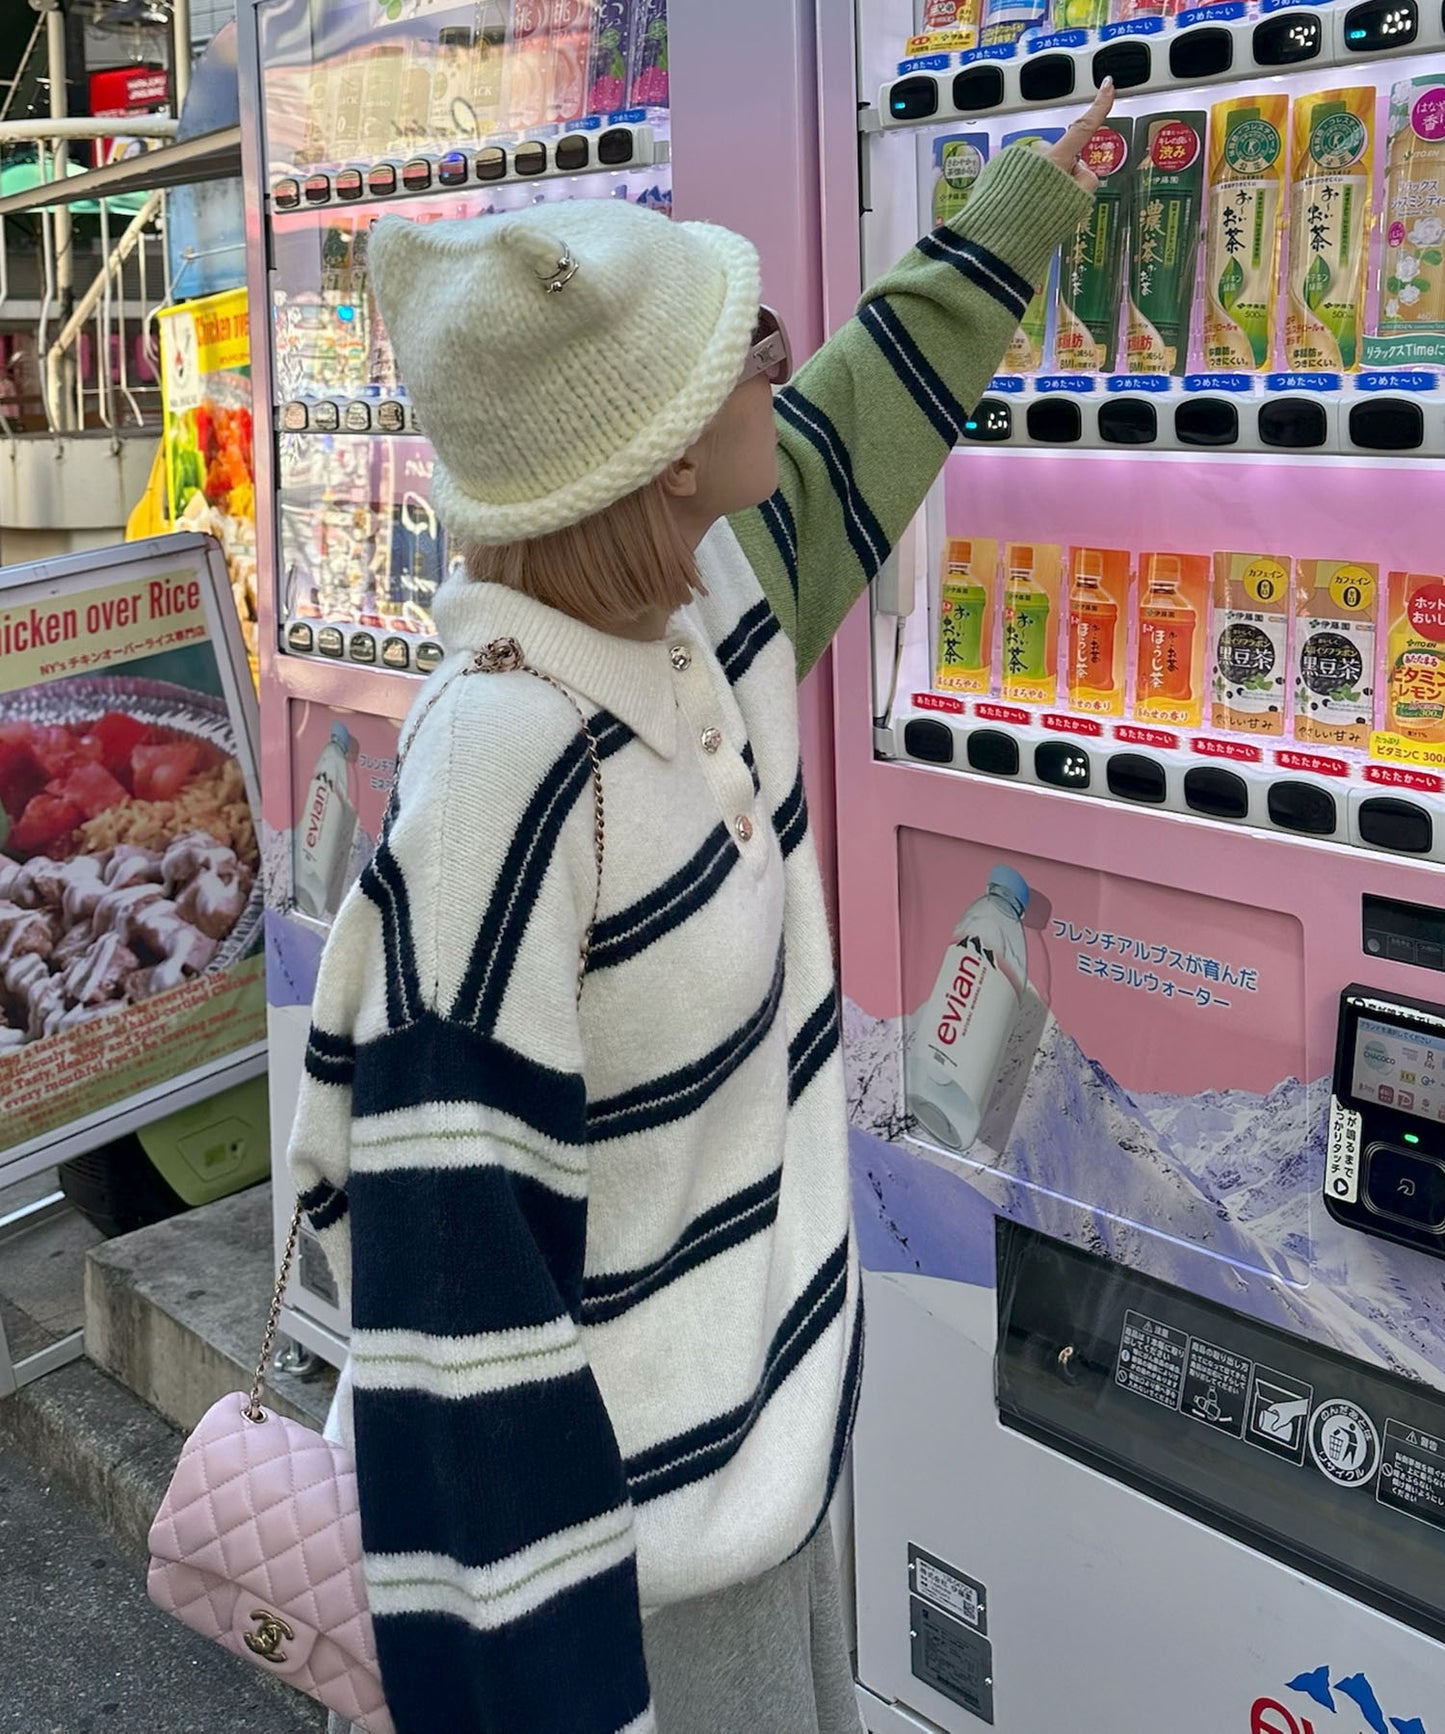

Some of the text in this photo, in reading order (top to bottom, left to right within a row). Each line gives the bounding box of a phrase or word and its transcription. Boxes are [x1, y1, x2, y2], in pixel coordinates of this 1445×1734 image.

[1108, 20, 1153, 37] つめた〜い
[1035, 34, 1078, 50] つめた〜い
[968, 46, 1008, 61] つめた〜い
[904, 57, 942, 72] つめた〜い
[1089, 150, 1114, 164] 渋み
[1158, 145, 1186, 160] 渋み
[1044, 380, 1085, 390] つめた〜い
[1115, 378, 1160, 390] つめた〜い
[1193, 376, 1240, 387] つめた〜い
[1276, 376, 1328, 386] つめた〜い
[1367, 376, 1423, 386] つめた〜い
[1248, 568, 1284, 580] カフェイン
[1334, 575, 1372, 586] カフェイン
[0, 579, 200, 656] icken over Rice
[1320, 620, 1350, 631] 伊藤園
[1150, 630, 1166, 688] ほうじ茶
[1219, 646, 1273, 670] 黒豆茶
[1302, 656, 1362, 680] 黒豆茶
[1400, 684, 1442, 700] レモン
[917, 696, 960, 710] あたたか〜い
[980, 706, 1026, 720] あたたか〜い
[1047, 716, 1096, 731] あたたか〜い
[1120, 728, 1172, 744] あたたか〜い
[1197, 740, 1255, 757] あたたか〜い
[1281, 752, 1342, 772] あたたか〜い
[1370, 768, 1436, 786] あたたか〜い
[306, 785, 327, 848] evian
[1052, 920, 1258, 991] フレンチアルプスが育んだ
[1077, 954, 1230, 1008] ミネラルウォーター
